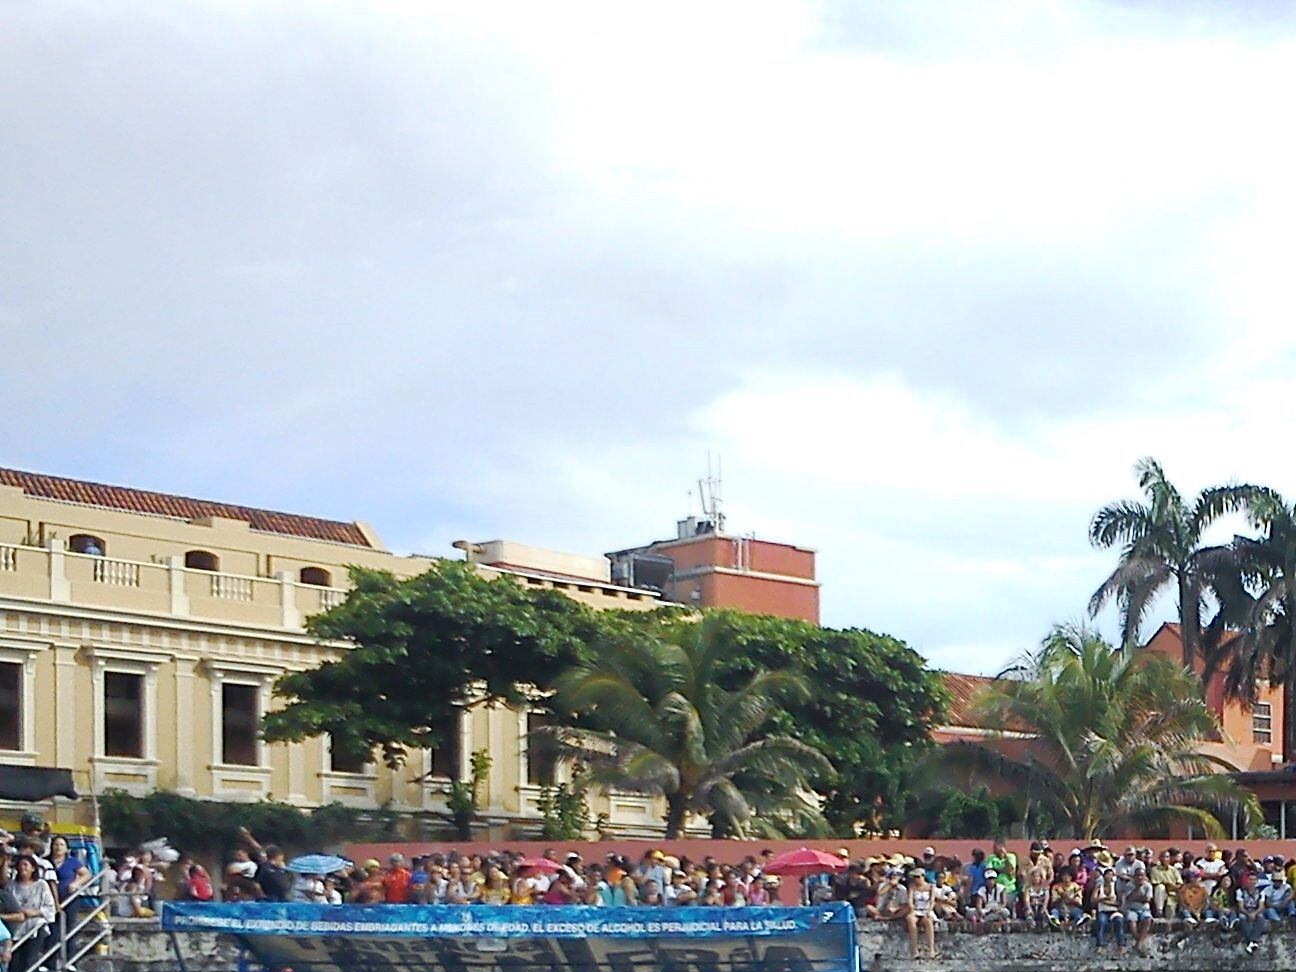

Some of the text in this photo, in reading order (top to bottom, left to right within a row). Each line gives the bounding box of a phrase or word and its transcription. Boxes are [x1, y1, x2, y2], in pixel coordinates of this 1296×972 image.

[312, 921, 353, 932] BEBIDAS
[354, 922, 428, 933] EMBRIAGANTES
[430, 923, 437, 932] A
[438, 923, 485, 932] MENORES
[532, 923, 544, 932] EL
[546, 923, 585, 932] EXCESO
[587, 923, 600, 932] DE
[602, 922, 647, 932] ALCOHOL
[649, 922, 661, 932] ES
[662, 922, 722, 932] PERJUDICIAL
[723, 921, 750, 932] PARA
[750, 921, 764, 931] LA
